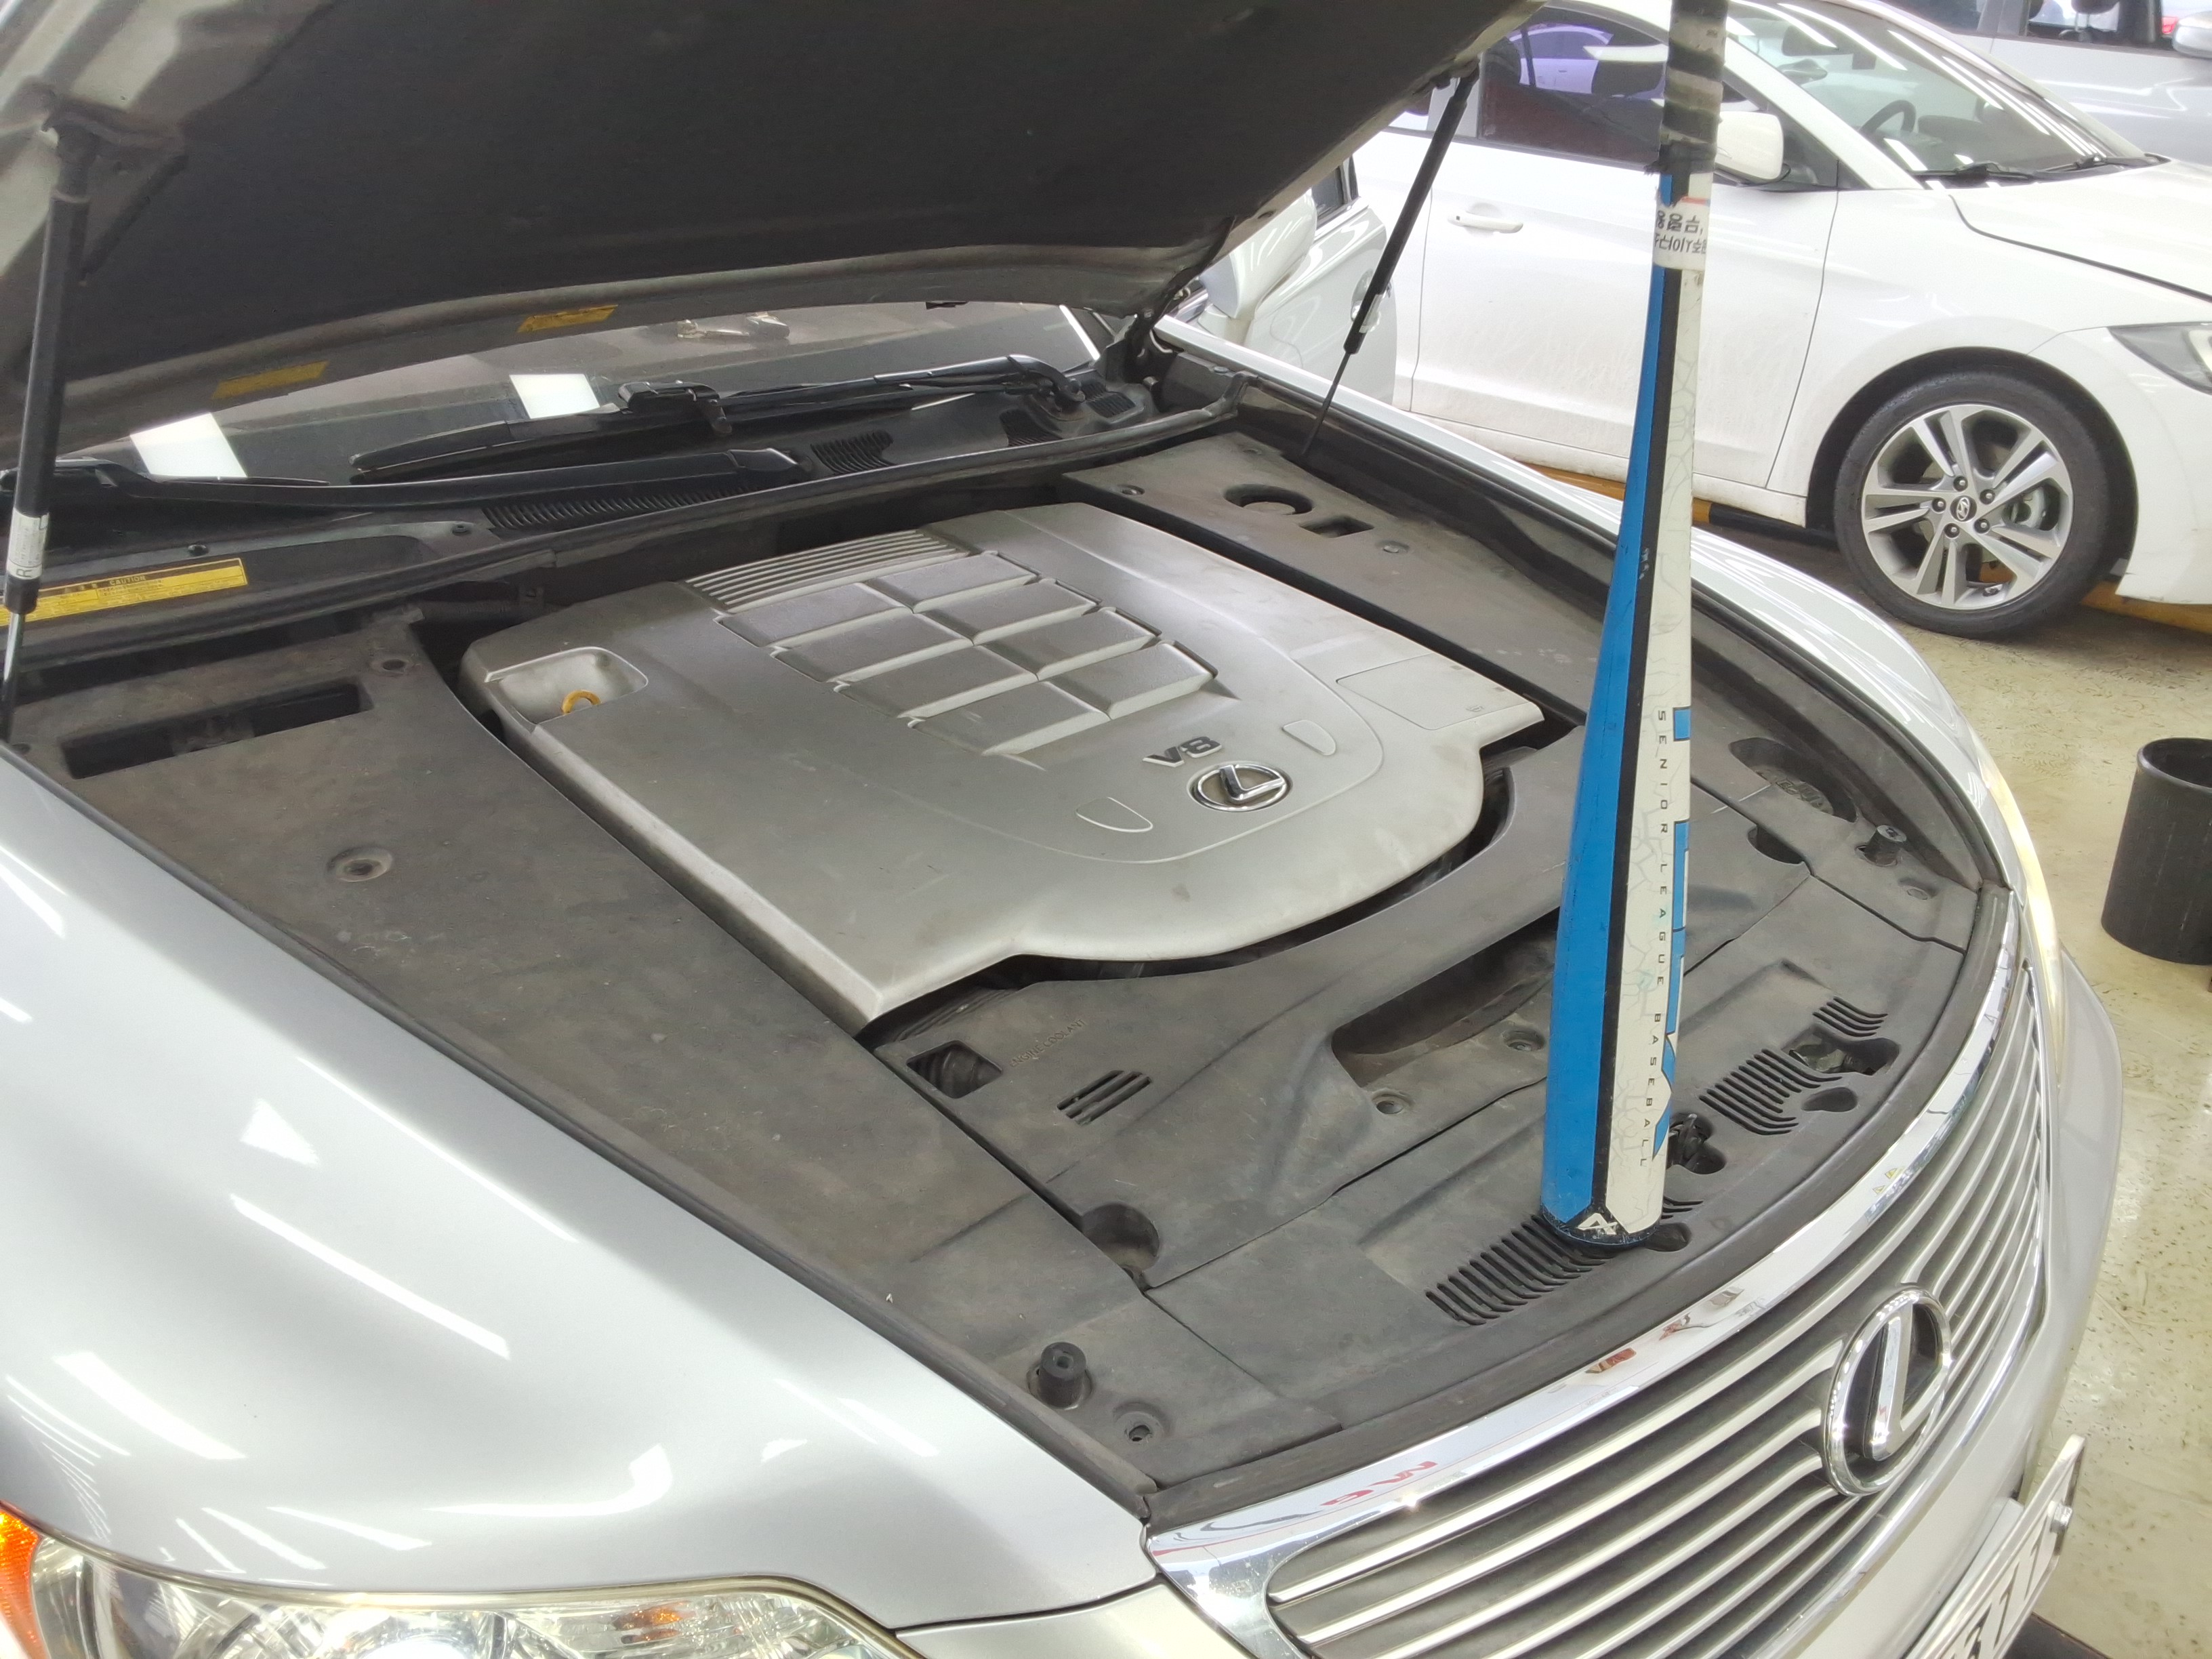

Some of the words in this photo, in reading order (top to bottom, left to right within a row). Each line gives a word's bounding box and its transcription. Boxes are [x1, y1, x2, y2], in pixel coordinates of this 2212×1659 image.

[109, 575, 147, 586] CAUTION
[1143, 736, 1223, 767] V8
[1657, 709, 1668, 834] SENIOR
[1657, 863, 1668, 985] LEAGUE
[1009, 1044, 1044, 1068] ENGINE
[1042, 1018, 1087, 1048] COOLANT
[1640, 1013, 1661, 1167] BASEBALL
